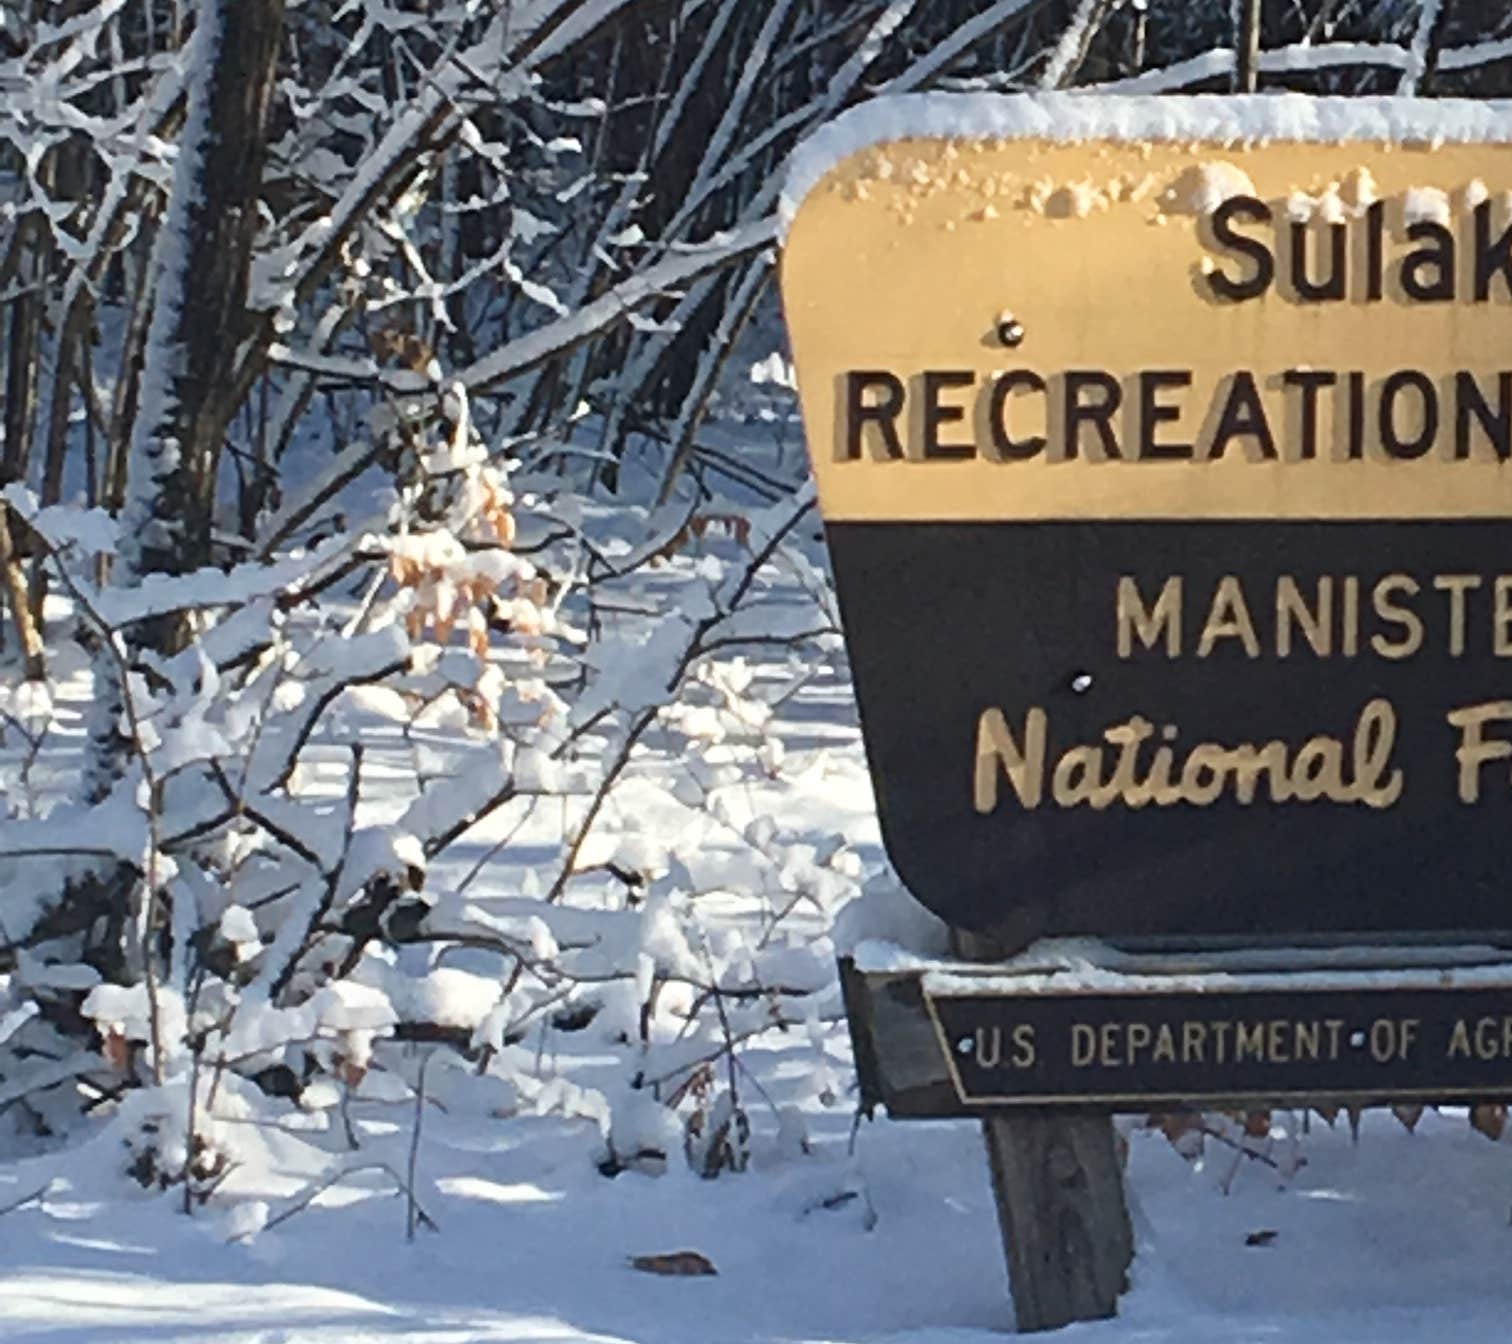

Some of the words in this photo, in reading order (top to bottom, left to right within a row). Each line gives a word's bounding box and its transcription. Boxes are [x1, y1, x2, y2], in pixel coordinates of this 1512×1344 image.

[973, 699, 1402, 814] National
[1071, 1021, 1344, 1068] DEPARTMENT
[1370, 1017, 1420, 1064] OF
